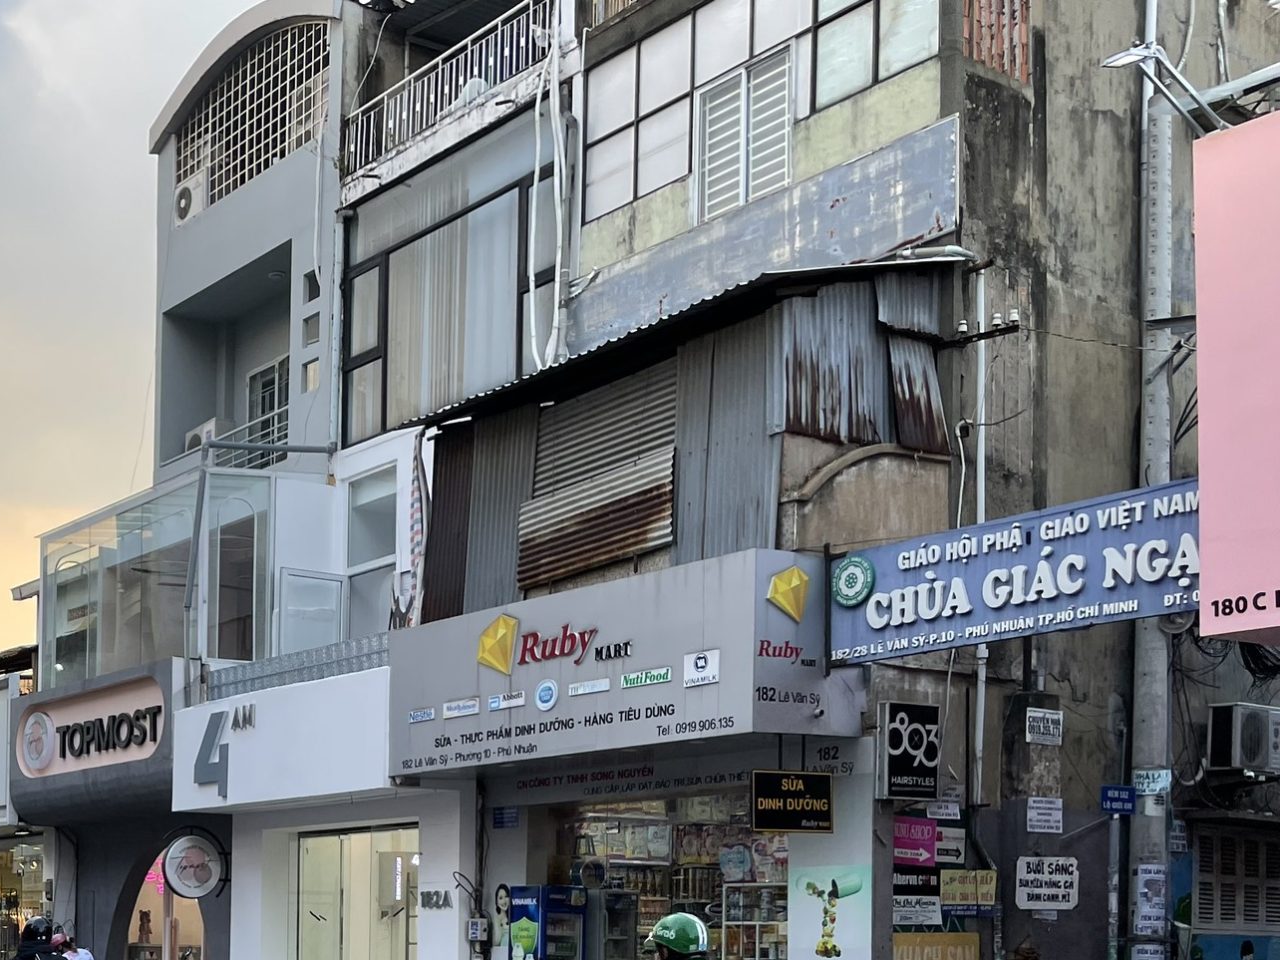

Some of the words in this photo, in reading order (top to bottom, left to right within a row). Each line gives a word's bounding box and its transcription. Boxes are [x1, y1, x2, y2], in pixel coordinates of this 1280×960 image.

[897, 543, 943, 571] GIÁO
[945, 534, 979, 564] HỘI
[1096, 500, 1147, 531] VIỆT
[865, 570, 974, 631] CHÙA
[982, 545, 1087, 609] GIÁC
[1211, 595, 1249, 618] 180
[1252, 591, 1267, 611] C
[830, 645, 868, 662] 182/28
[886, 637, 910, 652] VĂN
[965, 621, 990, 640] PHÚ
[992, 616, 1035, 634] NHUẬN
[1076, 603, 1100, 619] CHÍ
[1102, 599, 1139, 616] MINH
[1163, 593, 1189, 608] ĐT:
[517, 623, 599, 666] Ruby
[594, 640, 632, 661] MART
[758, 639, 804, 665] Ruby
[684, 675, 717, 686] VINAMILK
[501, 691, 524, 703] Abbott
[755, 686, 776, 702] 182
[778, 691, 790, 703] Lê
[791, 692, 808, 704] Văn
[809, 692, 821, 708] Sỹ
[56, 705, 162, 760] TOPMOST
[434, 734, 452, 749] SỮA
[514, 724, 536, 737] DINH
[539, 717, 575, 734] DƯỠNG
[584, 711, 614, 728] HÀNG
[618, 707, 641, 722] TIÊU
[645, 703, 676, 719] DÙNG
[675, 716, 735, 735] 0919.906.135
[193, 711, 229, 802] 4
[230, 704, 256, 732] AM
[401, 758, 413, 770] 182
[424, 755, 438, 767] Văn
[438, 753, 449, 767] Sỹ
[483, 749, 492, 759] 10
[816, 746, 840, 762] 182
[840, 761, 855, 776] Sỹ
[552, 776, 564, 787] TY
[781, 775, 805, 791] SỮA
[891, 775, 936, 787] HAIRSTYLES
[757, 797, 784, 810] DINH
[786, 794, 829, 811] DƯỠNG
[1047, 859, 1075, 876] SÁNG
[511, 898, 537, 906] VINAMILK
[656, 927, 676, 940] Grab
